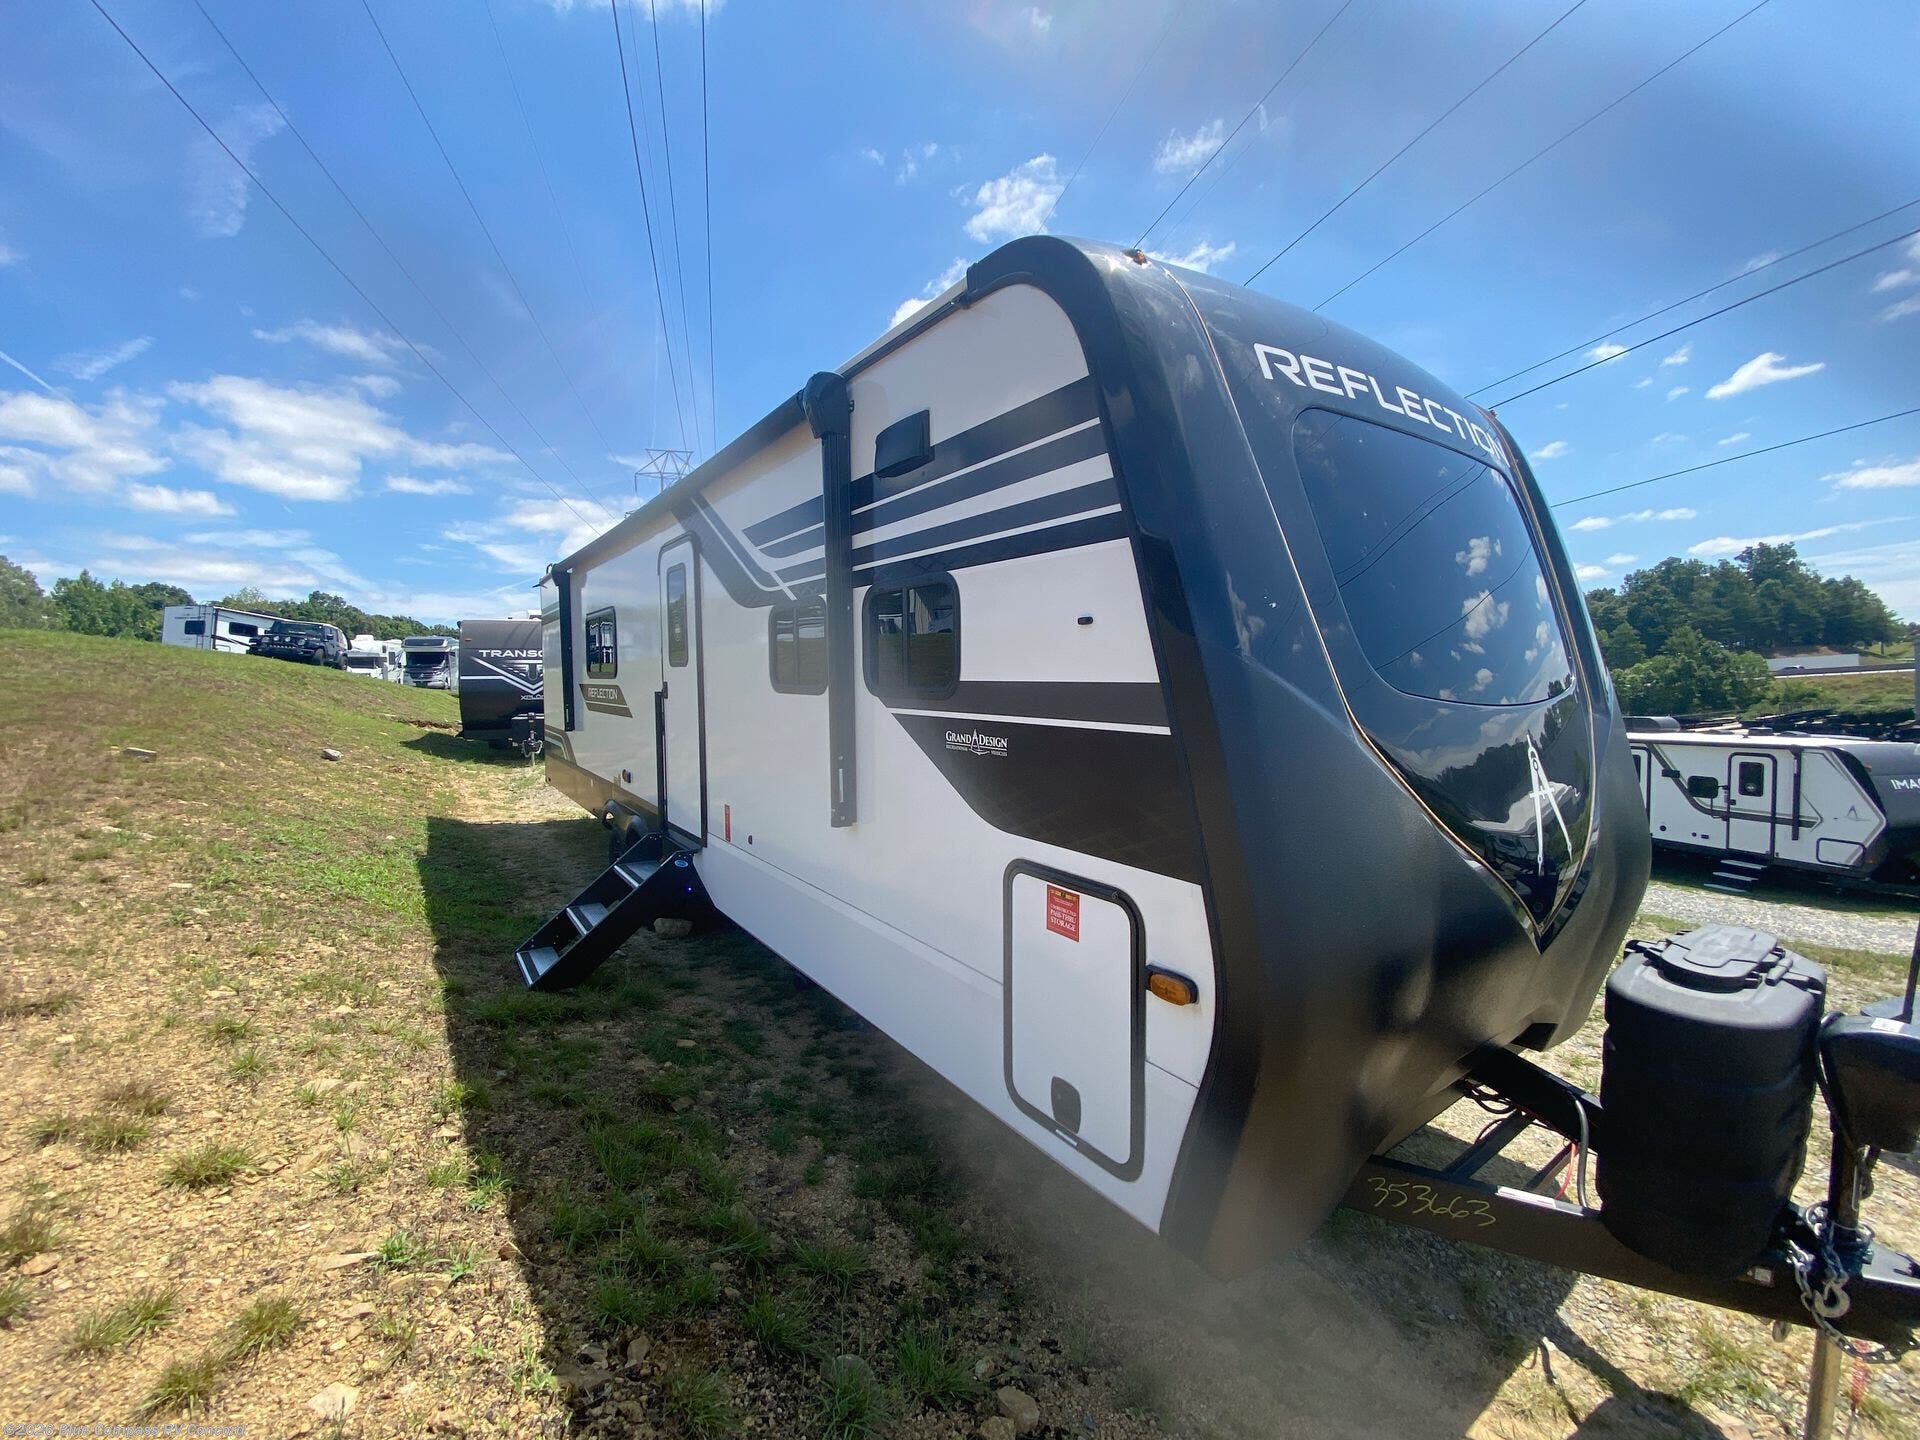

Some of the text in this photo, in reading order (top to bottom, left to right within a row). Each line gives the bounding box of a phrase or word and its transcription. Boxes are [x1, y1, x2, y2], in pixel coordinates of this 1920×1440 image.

[1253, 343, 1511, 468] REFLECTION
[945, 730, 972, 744] GRAND
[979, 734, 1009, 748] DESIGN
[1890, 778, 1920, 790] IMA
[1367, 1177, 1497, 1227] 353663
